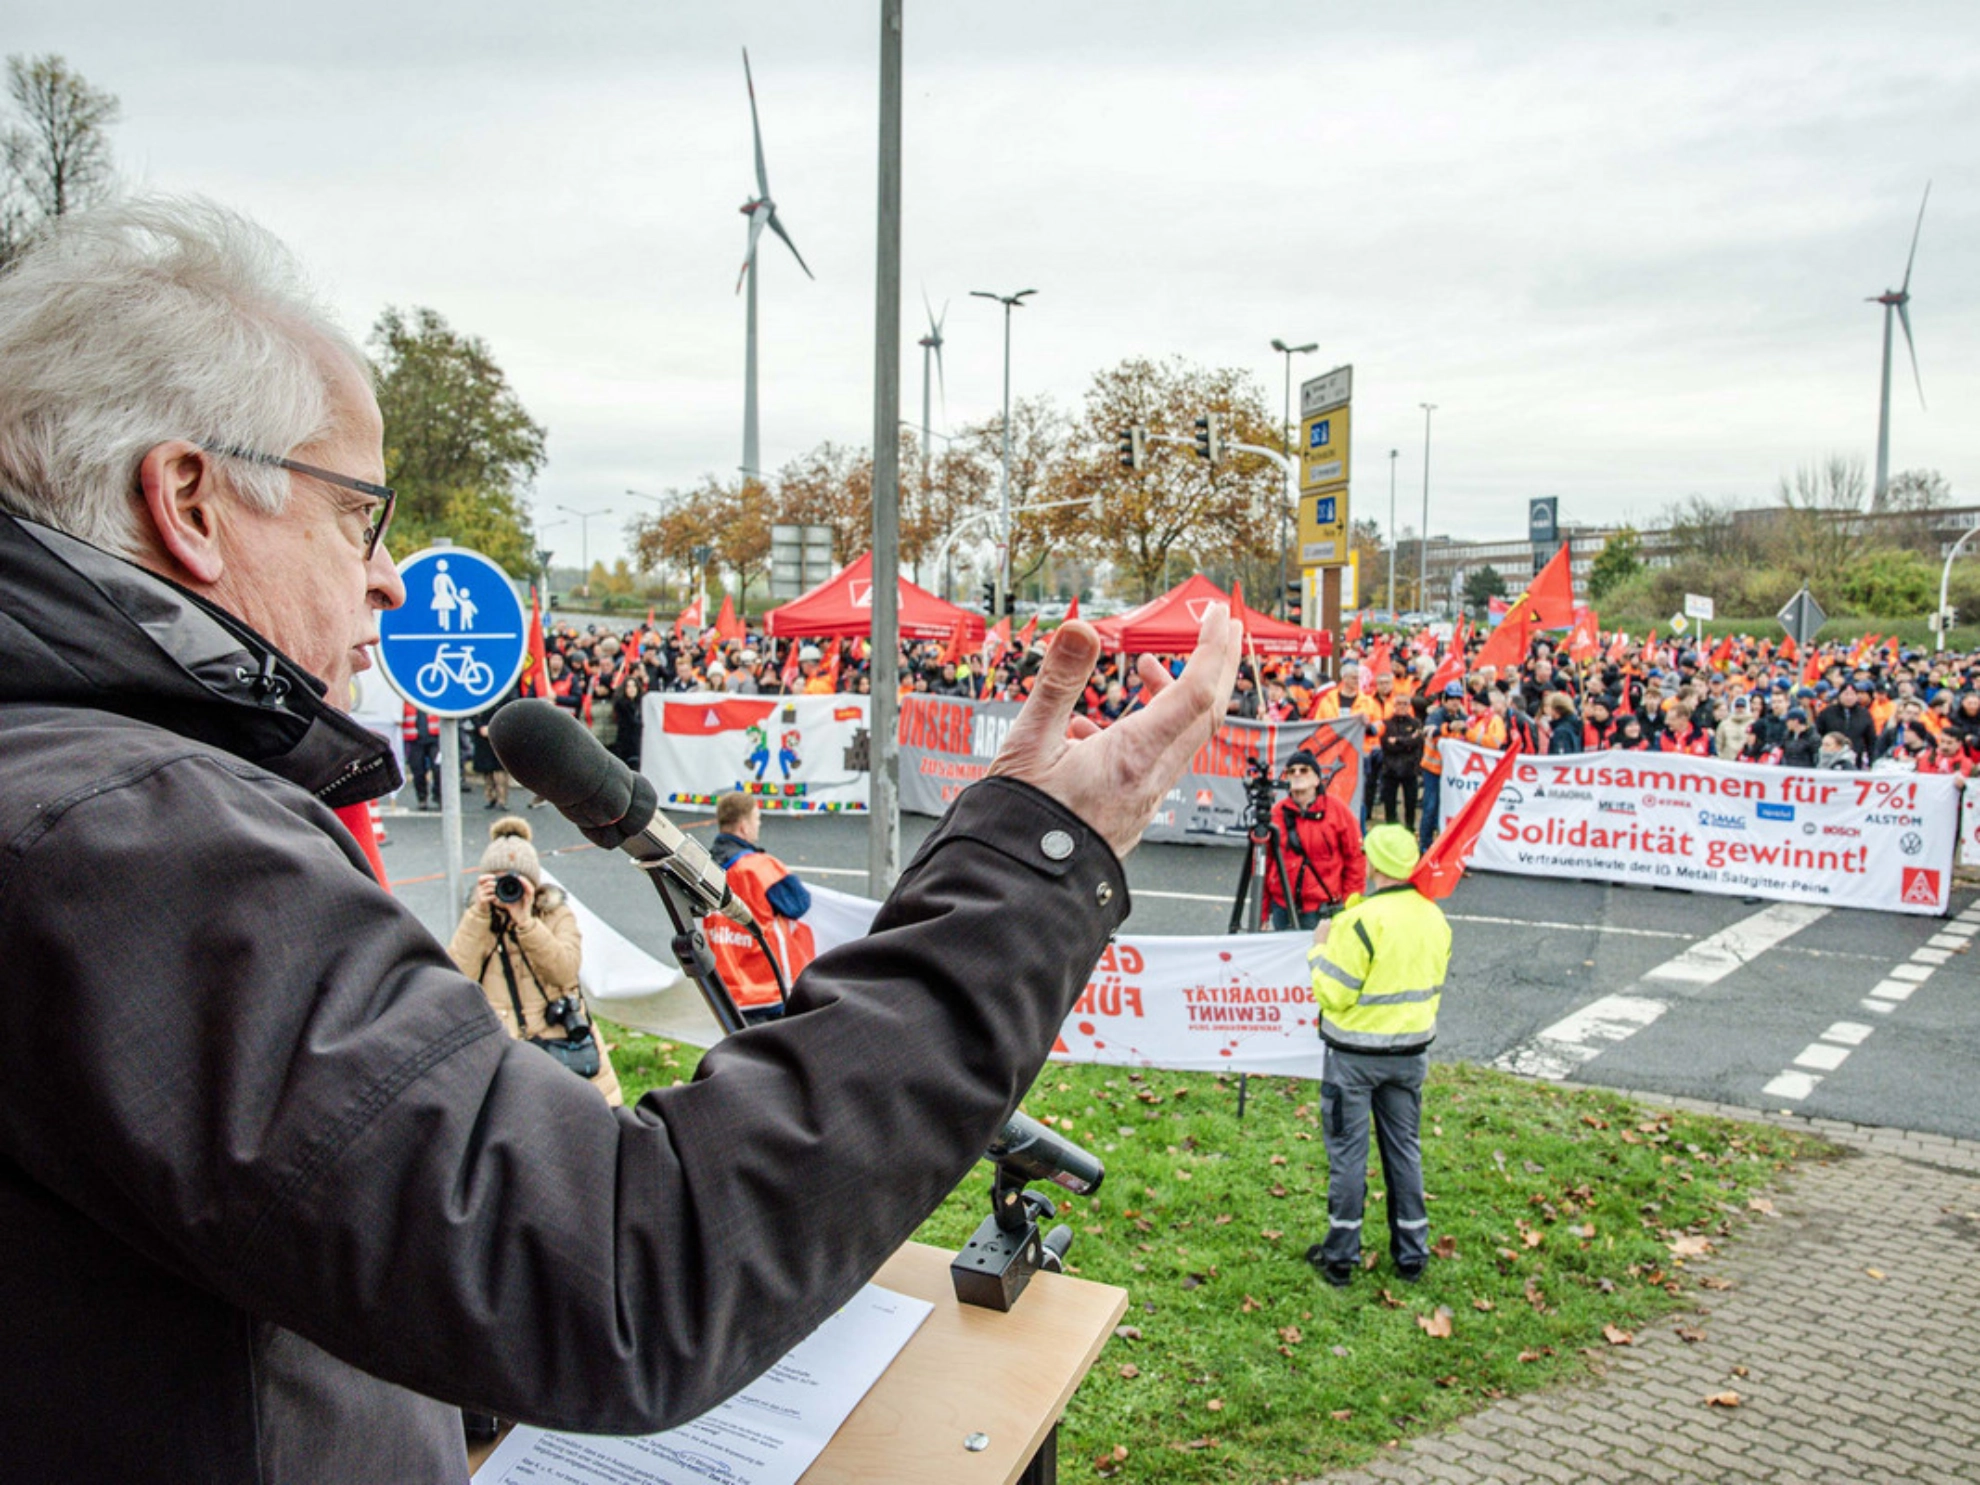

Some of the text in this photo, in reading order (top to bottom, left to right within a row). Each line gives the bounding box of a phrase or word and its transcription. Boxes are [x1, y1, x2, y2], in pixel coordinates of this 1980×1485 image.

[898, 696, 974, 756] UNSERE
[1447, 776, 1480, 792] VOIT
[1552, 766, 1766, 799] zusammen
[1781, 775, 1838, 804] für
[1853, 779, 1918, 810] 7%!
[1823, 825, 1861, 837] BOSCH
[1865, 813, 1923, 827] ALSTOM
[1498, 813, 1868, 874] Solidarität gewinnt!
[1518, 852, 1830, 894] Vertrauensleute der IG Metall Salzgitter-Peine
